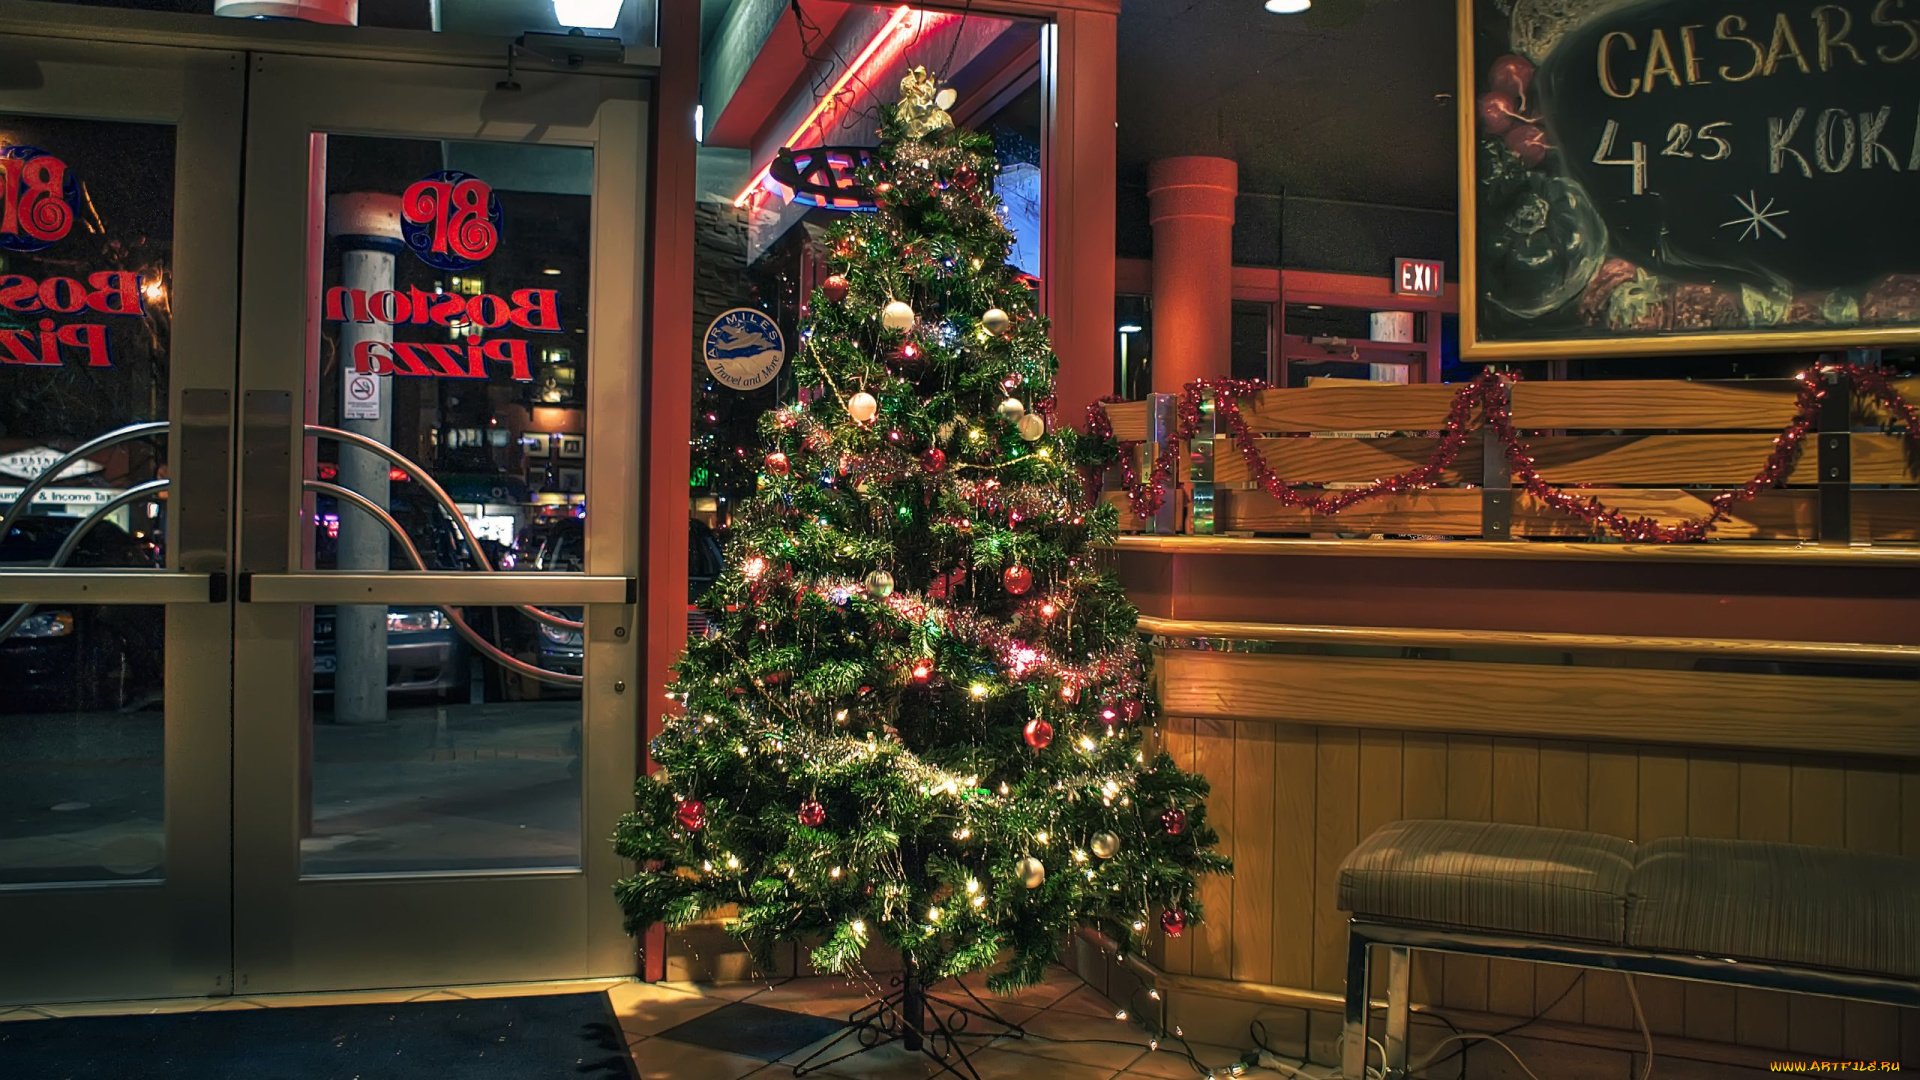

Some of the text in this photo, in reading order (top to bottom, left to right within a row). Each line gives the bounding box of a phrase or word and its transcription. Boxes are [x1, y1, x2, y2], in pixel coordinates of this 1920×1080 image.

[1597, 0, 1920, 98] CAESARS
[1402, 262, 1440, 292] EXIT
[707, 312, 778, 358] AIR MILES
[714, 355, 780, 387] Travel and More
[38, 492, 47, 500] &
[51, 491, 91, 501] Income
